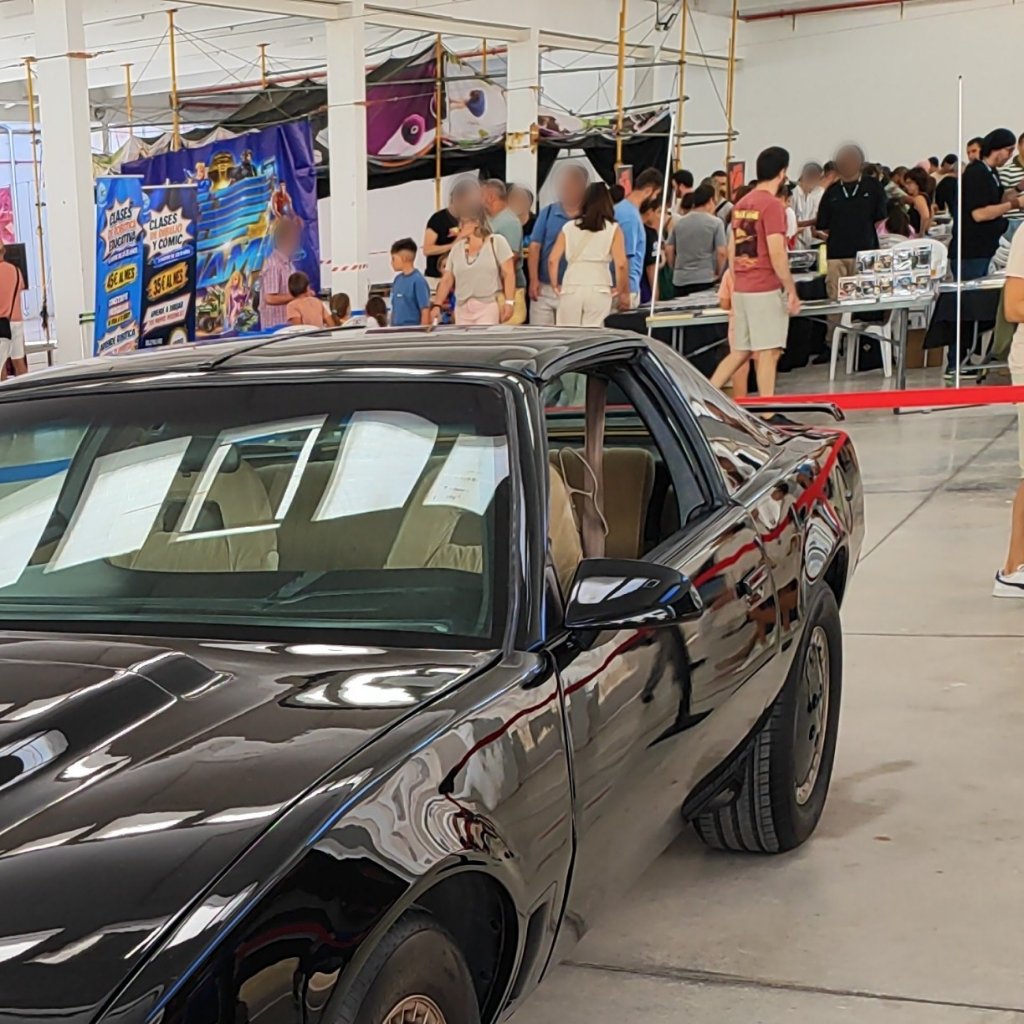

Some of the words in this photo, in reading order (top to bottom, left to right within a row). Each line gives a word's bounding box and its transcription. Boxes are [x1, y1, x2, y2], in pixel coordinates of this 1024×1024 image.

[109, 206, 132, 226] CLASES
[149, 212, 178, 231] CLASES
[152, 240, 158, 251] Y
[158, 233, 183, 249] COMIC
